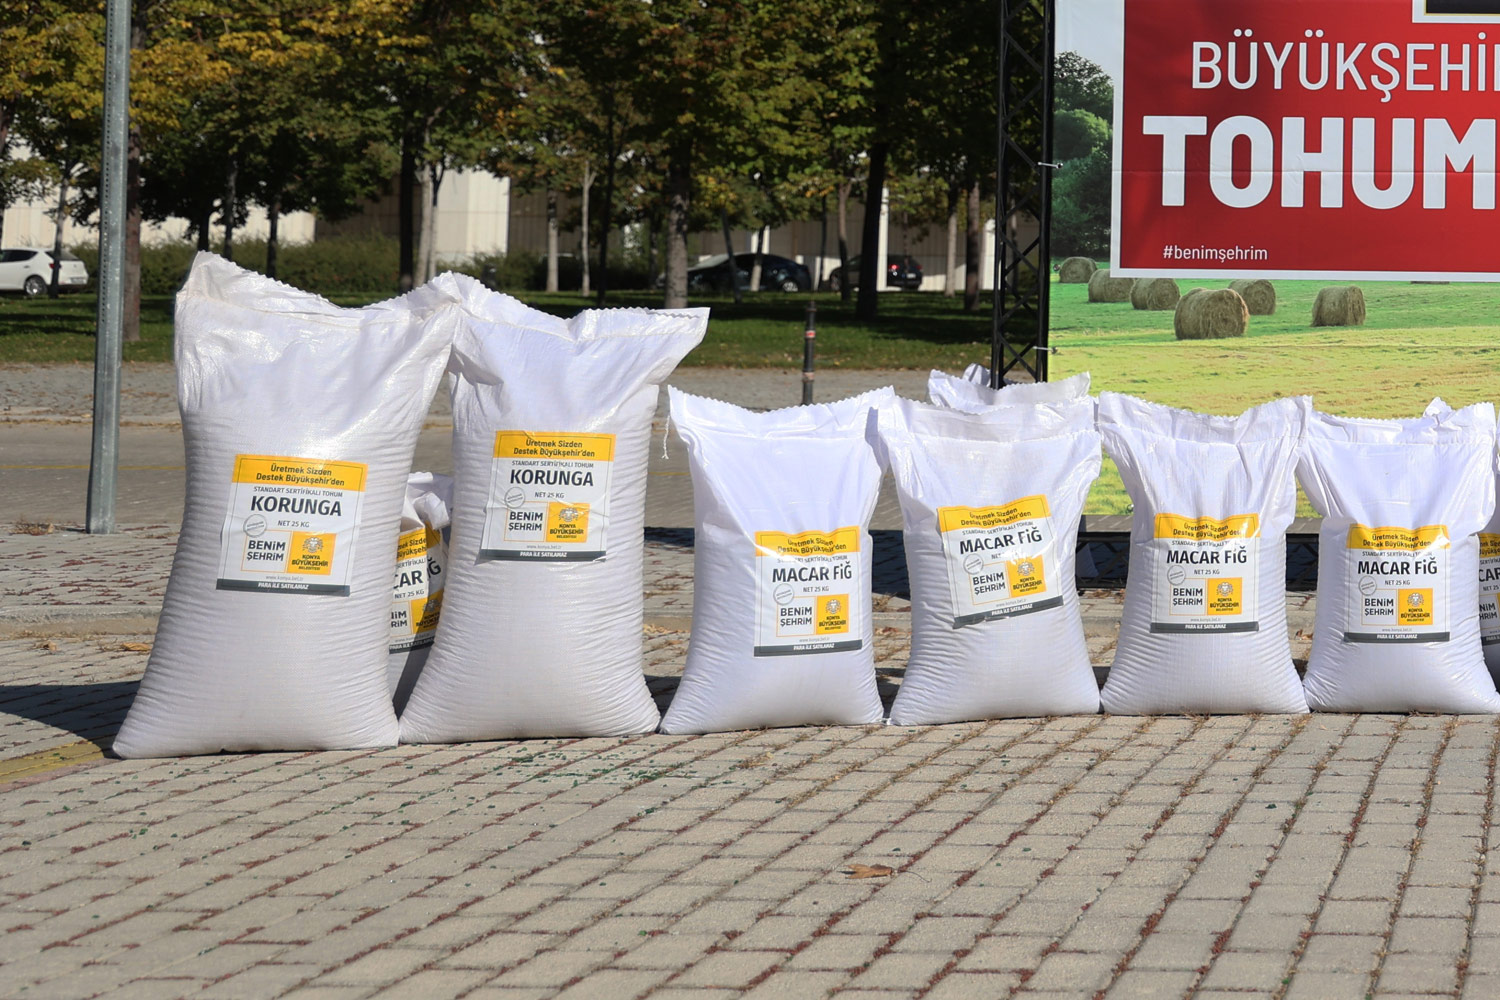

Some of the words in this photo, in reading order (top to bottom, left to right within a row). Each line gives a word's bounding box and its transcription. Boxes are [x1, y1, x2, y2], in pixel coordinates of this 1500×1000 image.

[1142, 115, 1496, 210] TOHUM
[1163, 245, 1268, 263] #benimşehrim
[558, 440, 582, 448] Sizden
[271, 463, 304, 474] Üretmek
[307, 467, 331, 476] Sizden
[256, 473, 283, 481] Destek
[286, 475, 344, 486] Büyükşehir'den
[510, 469, 594, 486] KORUNGA
[251, 496, 341, 516] KORUNGA
[960, 534, 1015, 555] MACAR
[1167, 550, 1220, 564] MACAR
[772, 567, 829, 583] MACAR
[1358, 561, 1410, 575] MACAR
[395, 591, 406, 599] NET
